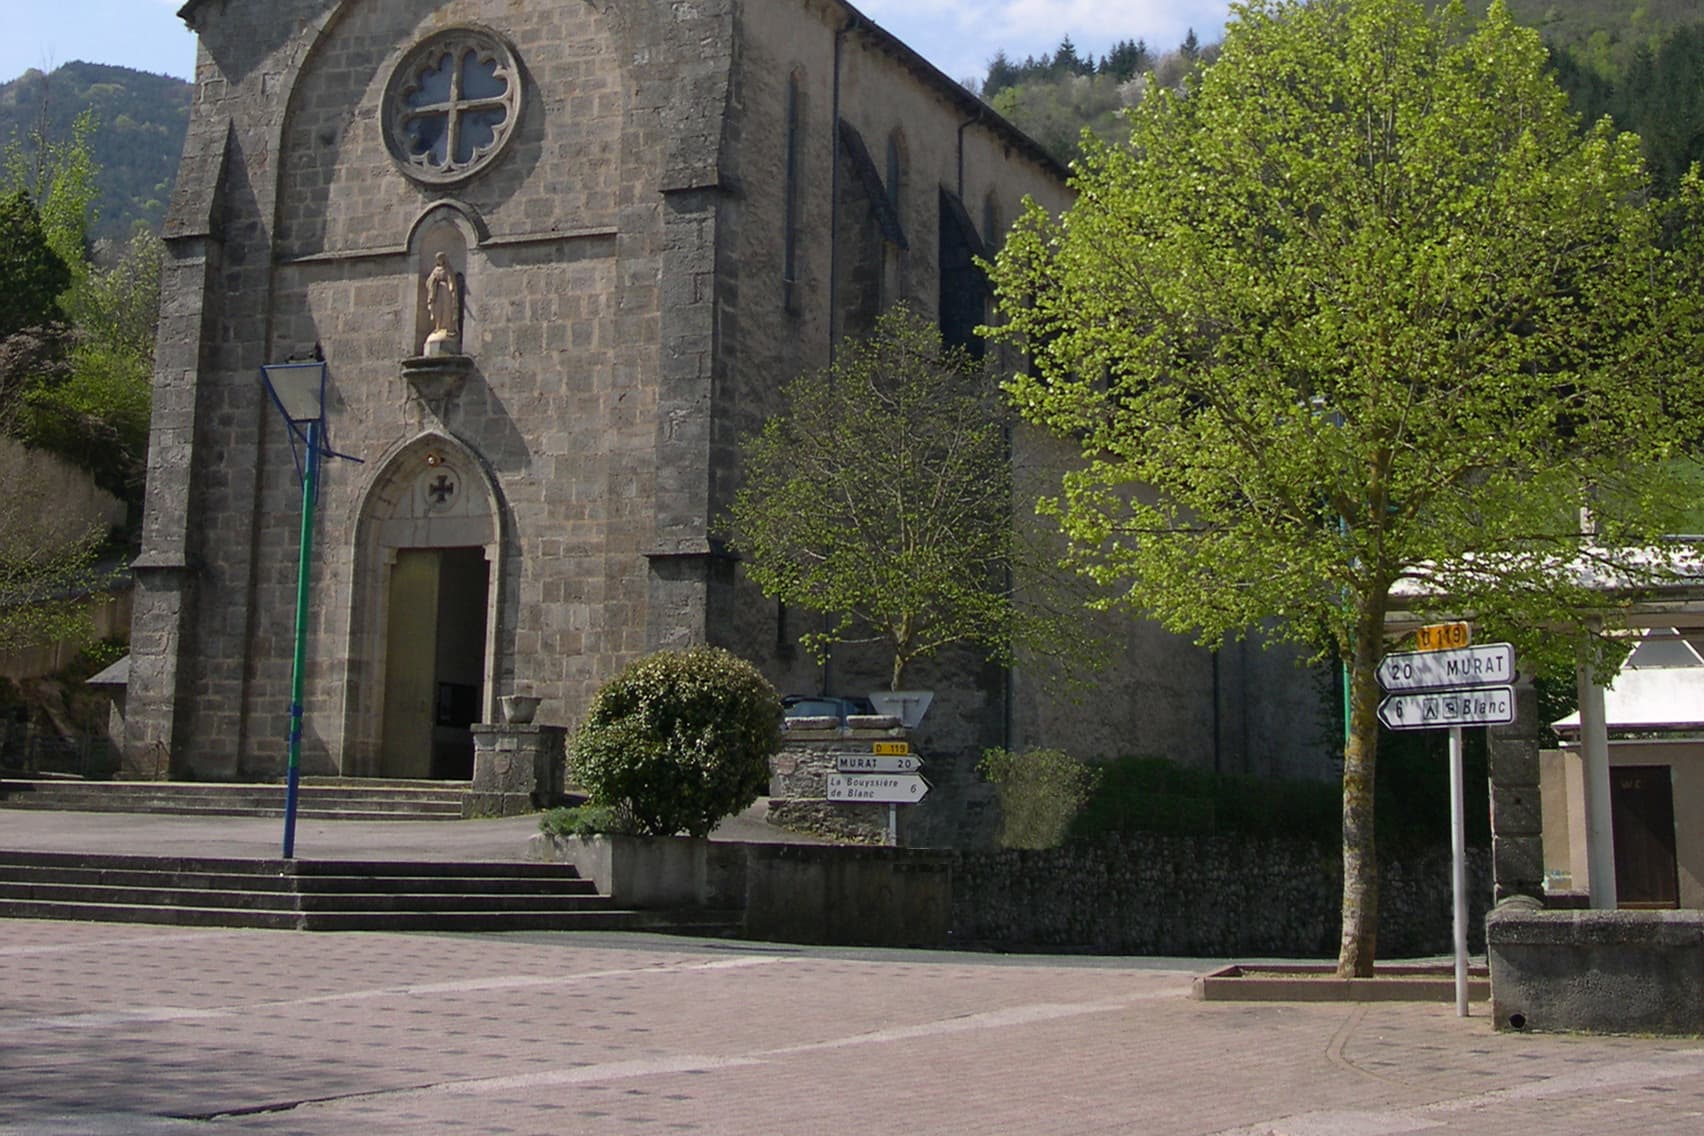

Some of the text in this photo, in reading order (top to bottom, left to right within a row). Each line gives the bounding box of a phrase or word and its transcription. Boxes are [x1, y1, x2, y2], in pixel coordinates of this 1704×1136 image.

[1392, 656, 1504, 681] 20 MURAT
[1395, 698, 1506, 719] 6 Blanc
[876, 744, 906, 752] D 119
[839, 758, 912, 768] MURAT 20
[830, 777, 899, 788] La Bouyssière
[830, 789, 875, 798] de Blanc
[910, 784, 916, 793] 6
